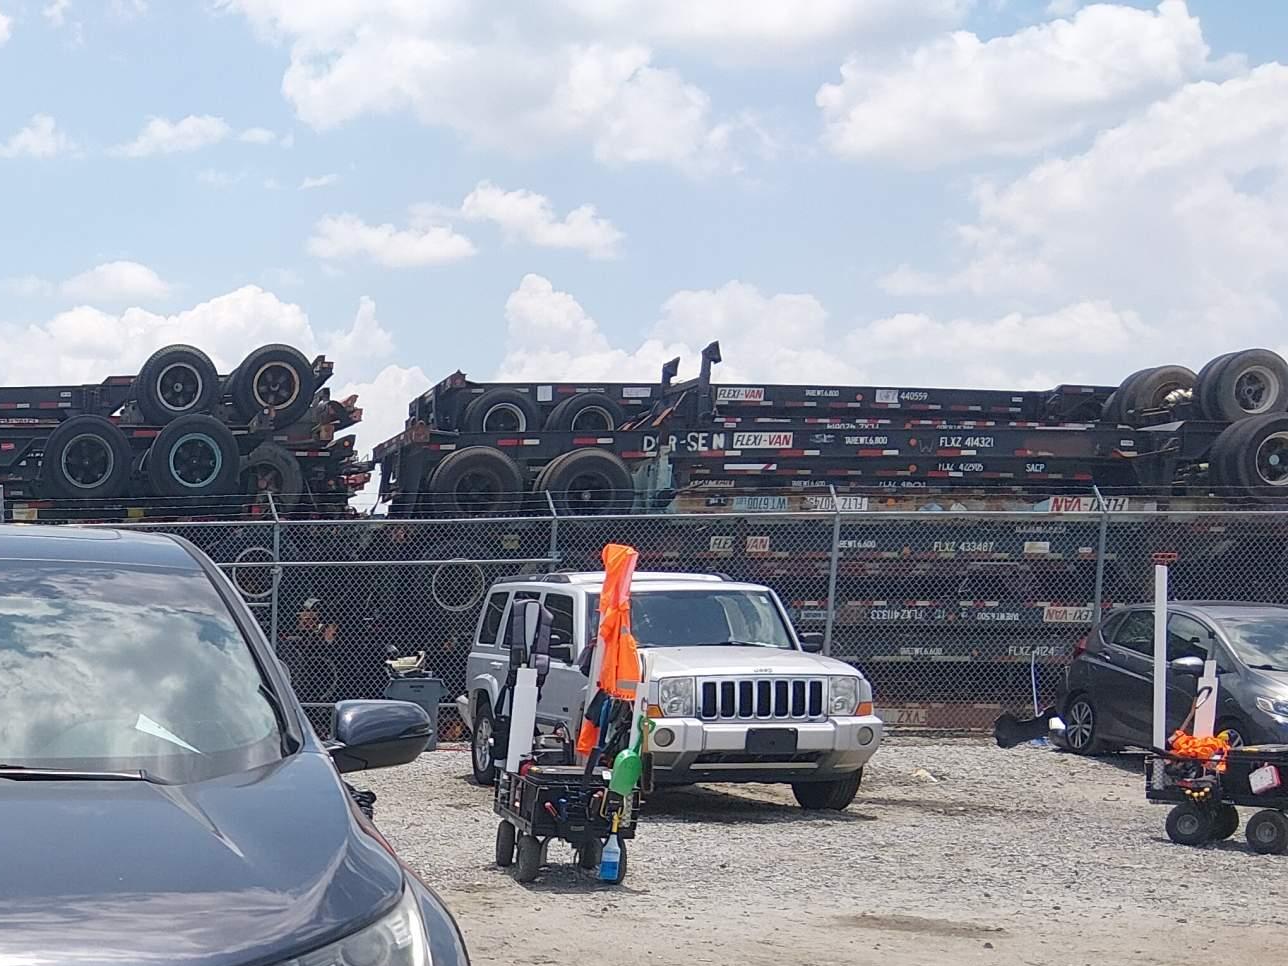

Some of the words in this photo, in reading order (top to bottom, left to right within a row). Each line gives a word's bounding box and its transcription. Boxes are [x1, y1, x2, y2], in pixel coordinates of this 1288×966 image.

[718, 388, 763, 399] FLEXI-VAN
[734, 434, 792, 446] FLEXI-VAN
[939, 436, 962, 448] FLXZ
[965, 436, 994, 448] 414321
[1025, 463, 1045, 472] SACP
[1046, 609, 1093, 621] EXI-VAN
